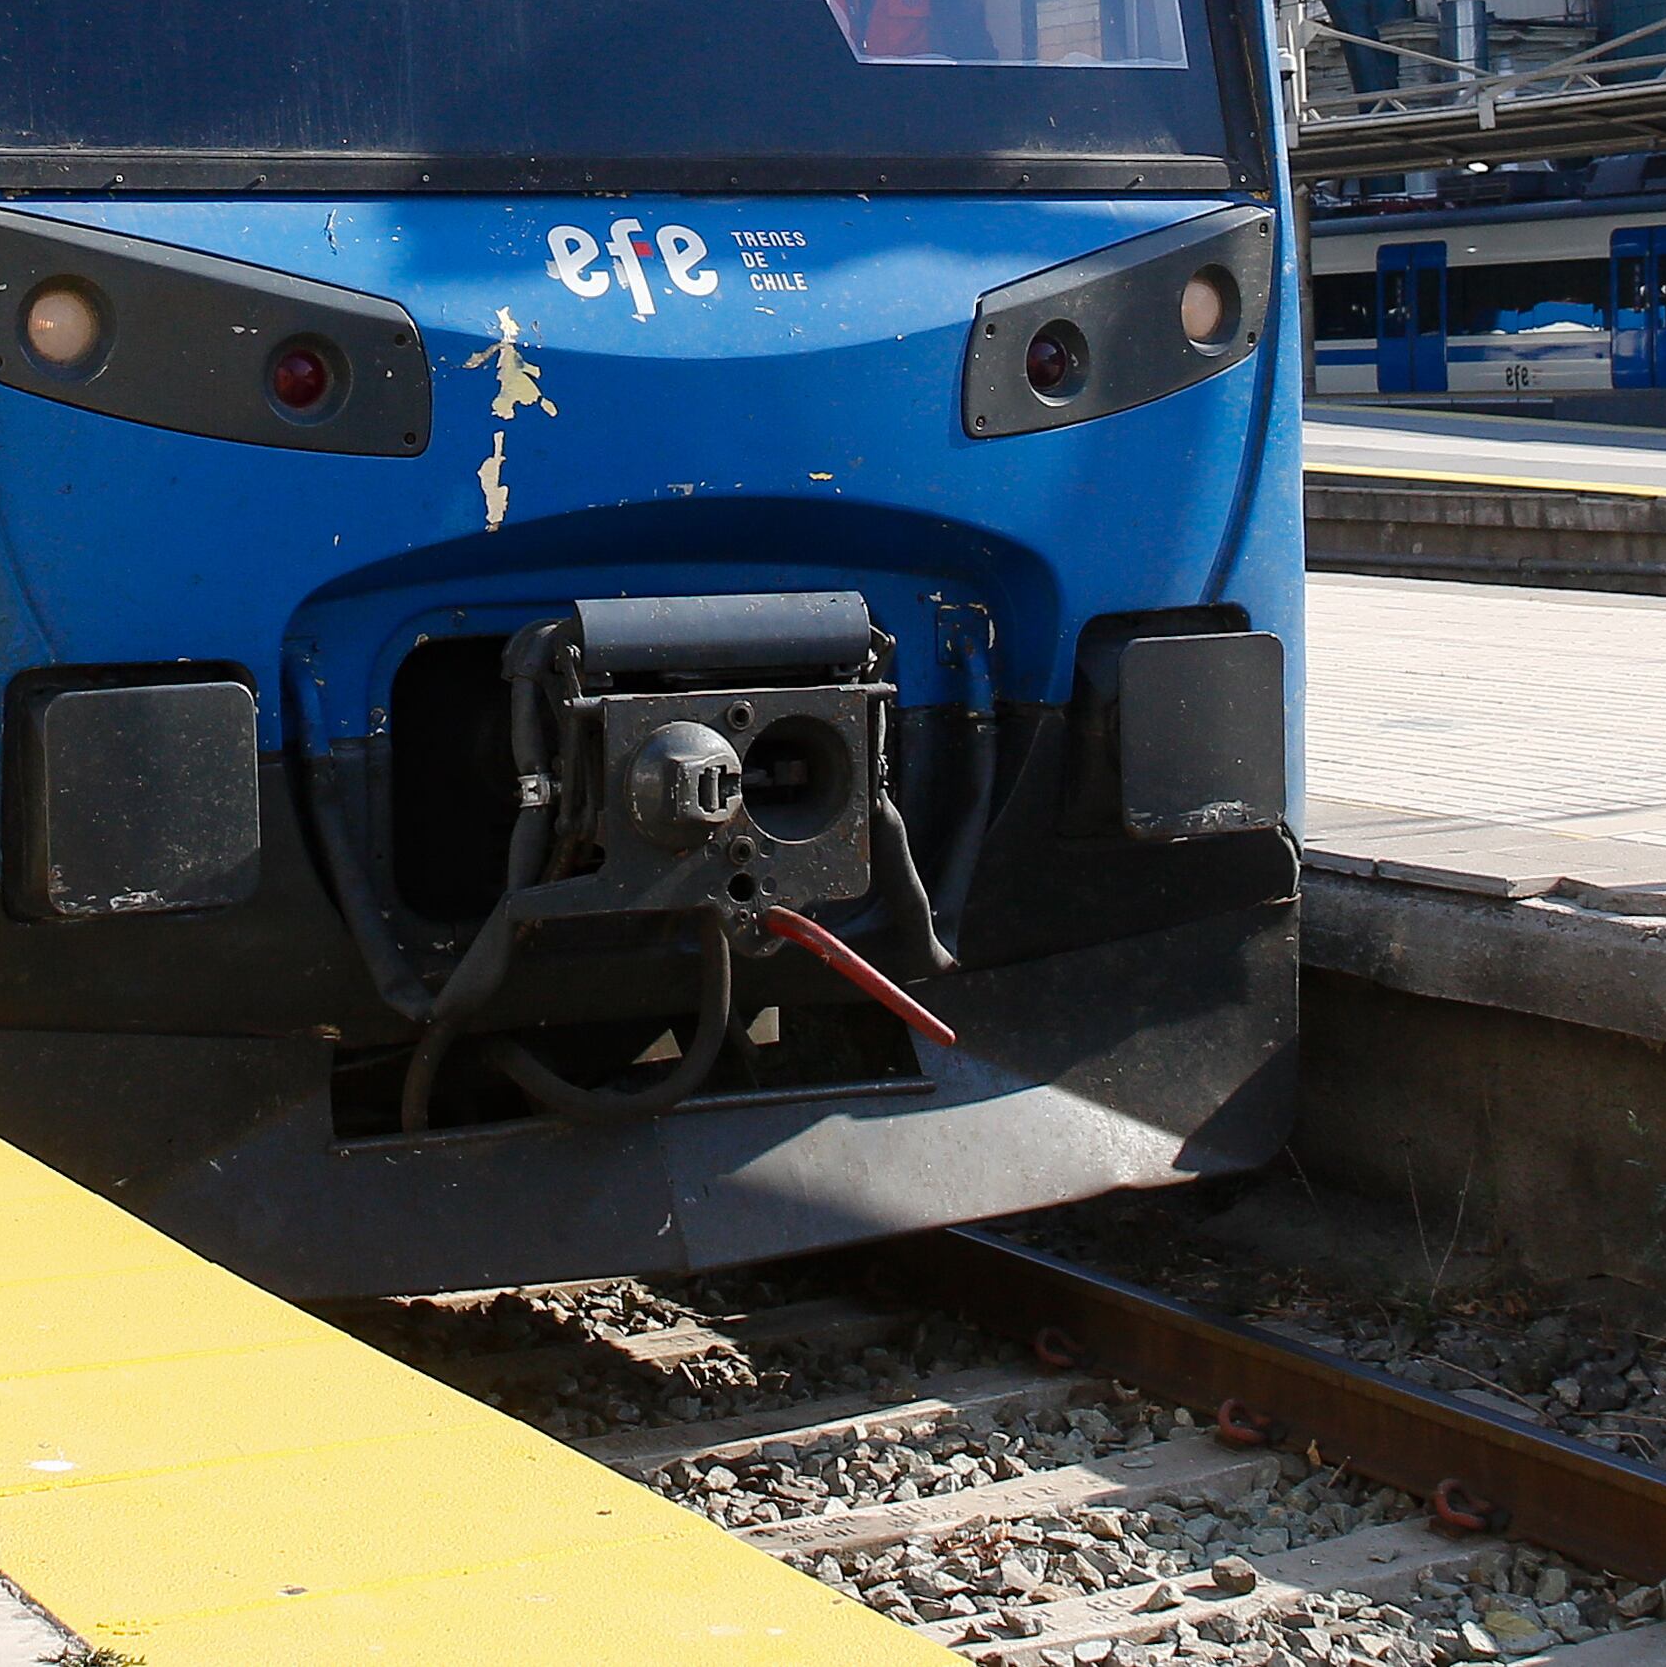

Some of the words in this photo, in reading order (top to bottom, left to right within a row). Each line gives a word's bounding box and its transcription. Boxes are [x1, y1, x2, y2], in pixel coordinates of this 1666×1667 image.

[547, 218, 719, 315] efe
[740, 251, 768, 268] DE
[749, 273, 808, 291] CHILE
[1505, 364, 1529, 390] efe
